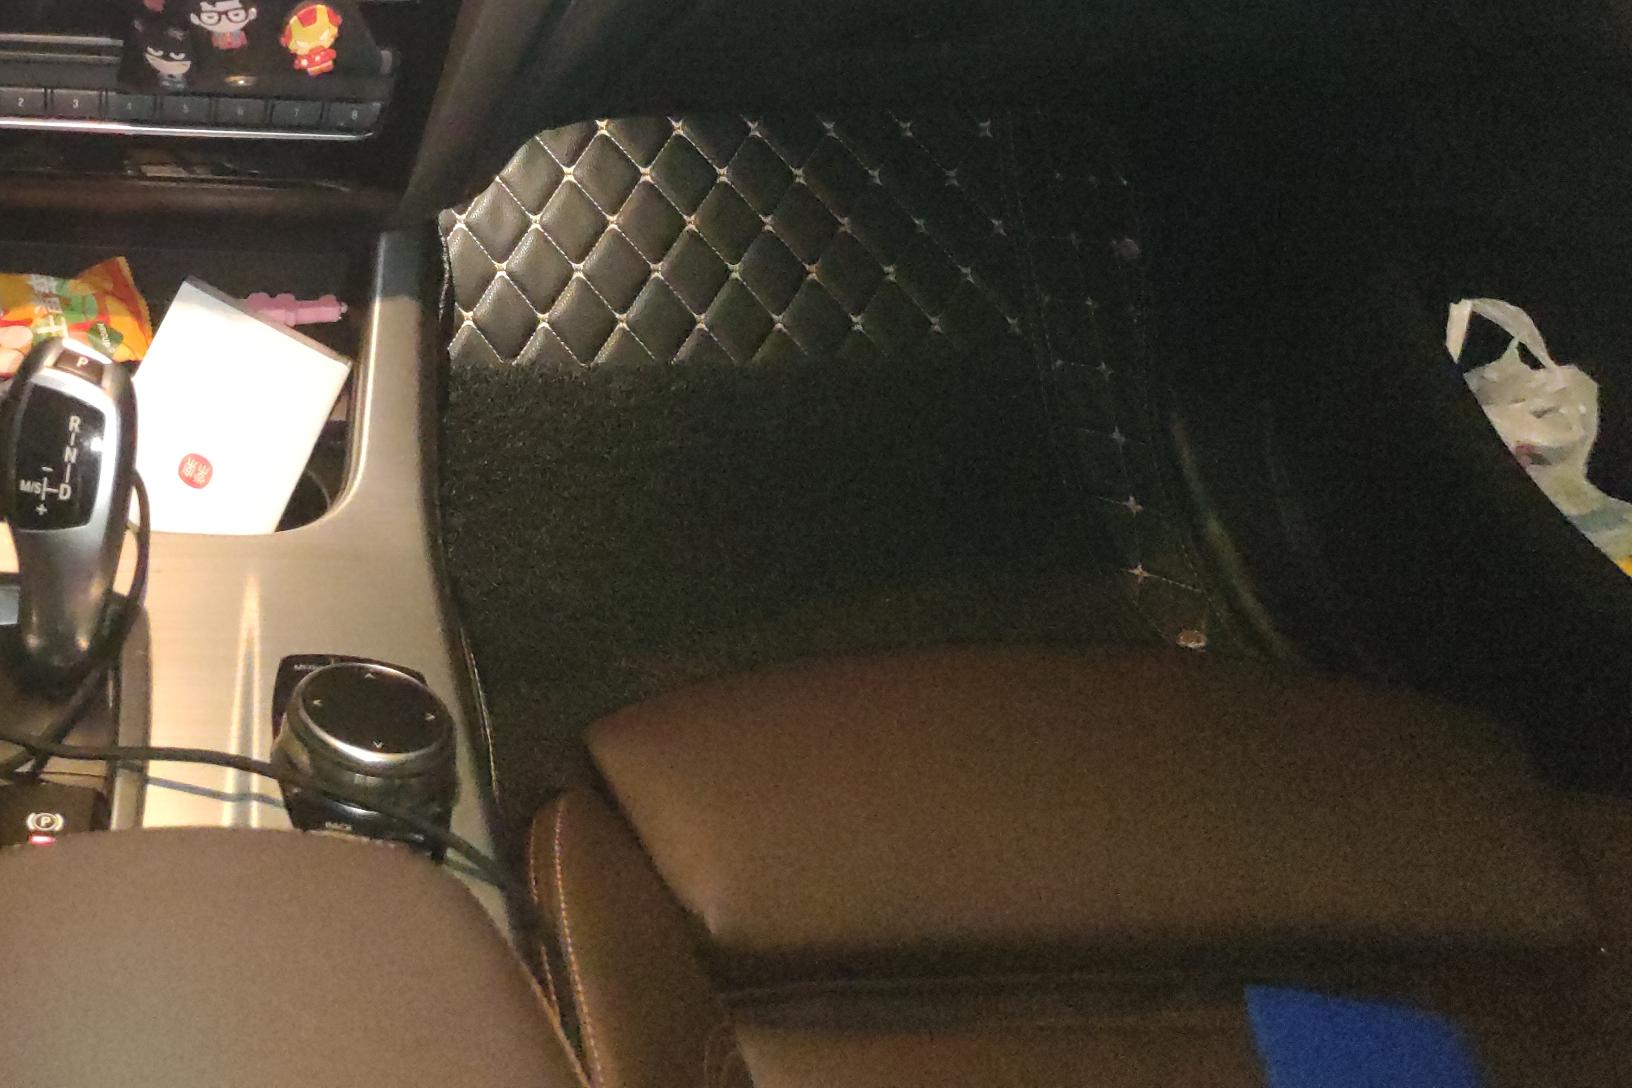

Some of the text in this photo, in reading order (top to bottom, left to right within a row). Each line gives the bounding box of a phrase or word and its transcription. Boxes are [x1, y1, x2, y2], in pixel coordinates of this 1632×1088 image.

[18, 97, 24, 107] 2
[72, 99, 79, 109] 3
[76, 356, 89, 368] P
[69, 415, 81, 433] R
[64, 446, 77, 463] N
[19, 479, 42, 494] M/S
[58, 483, 72, 501] D
